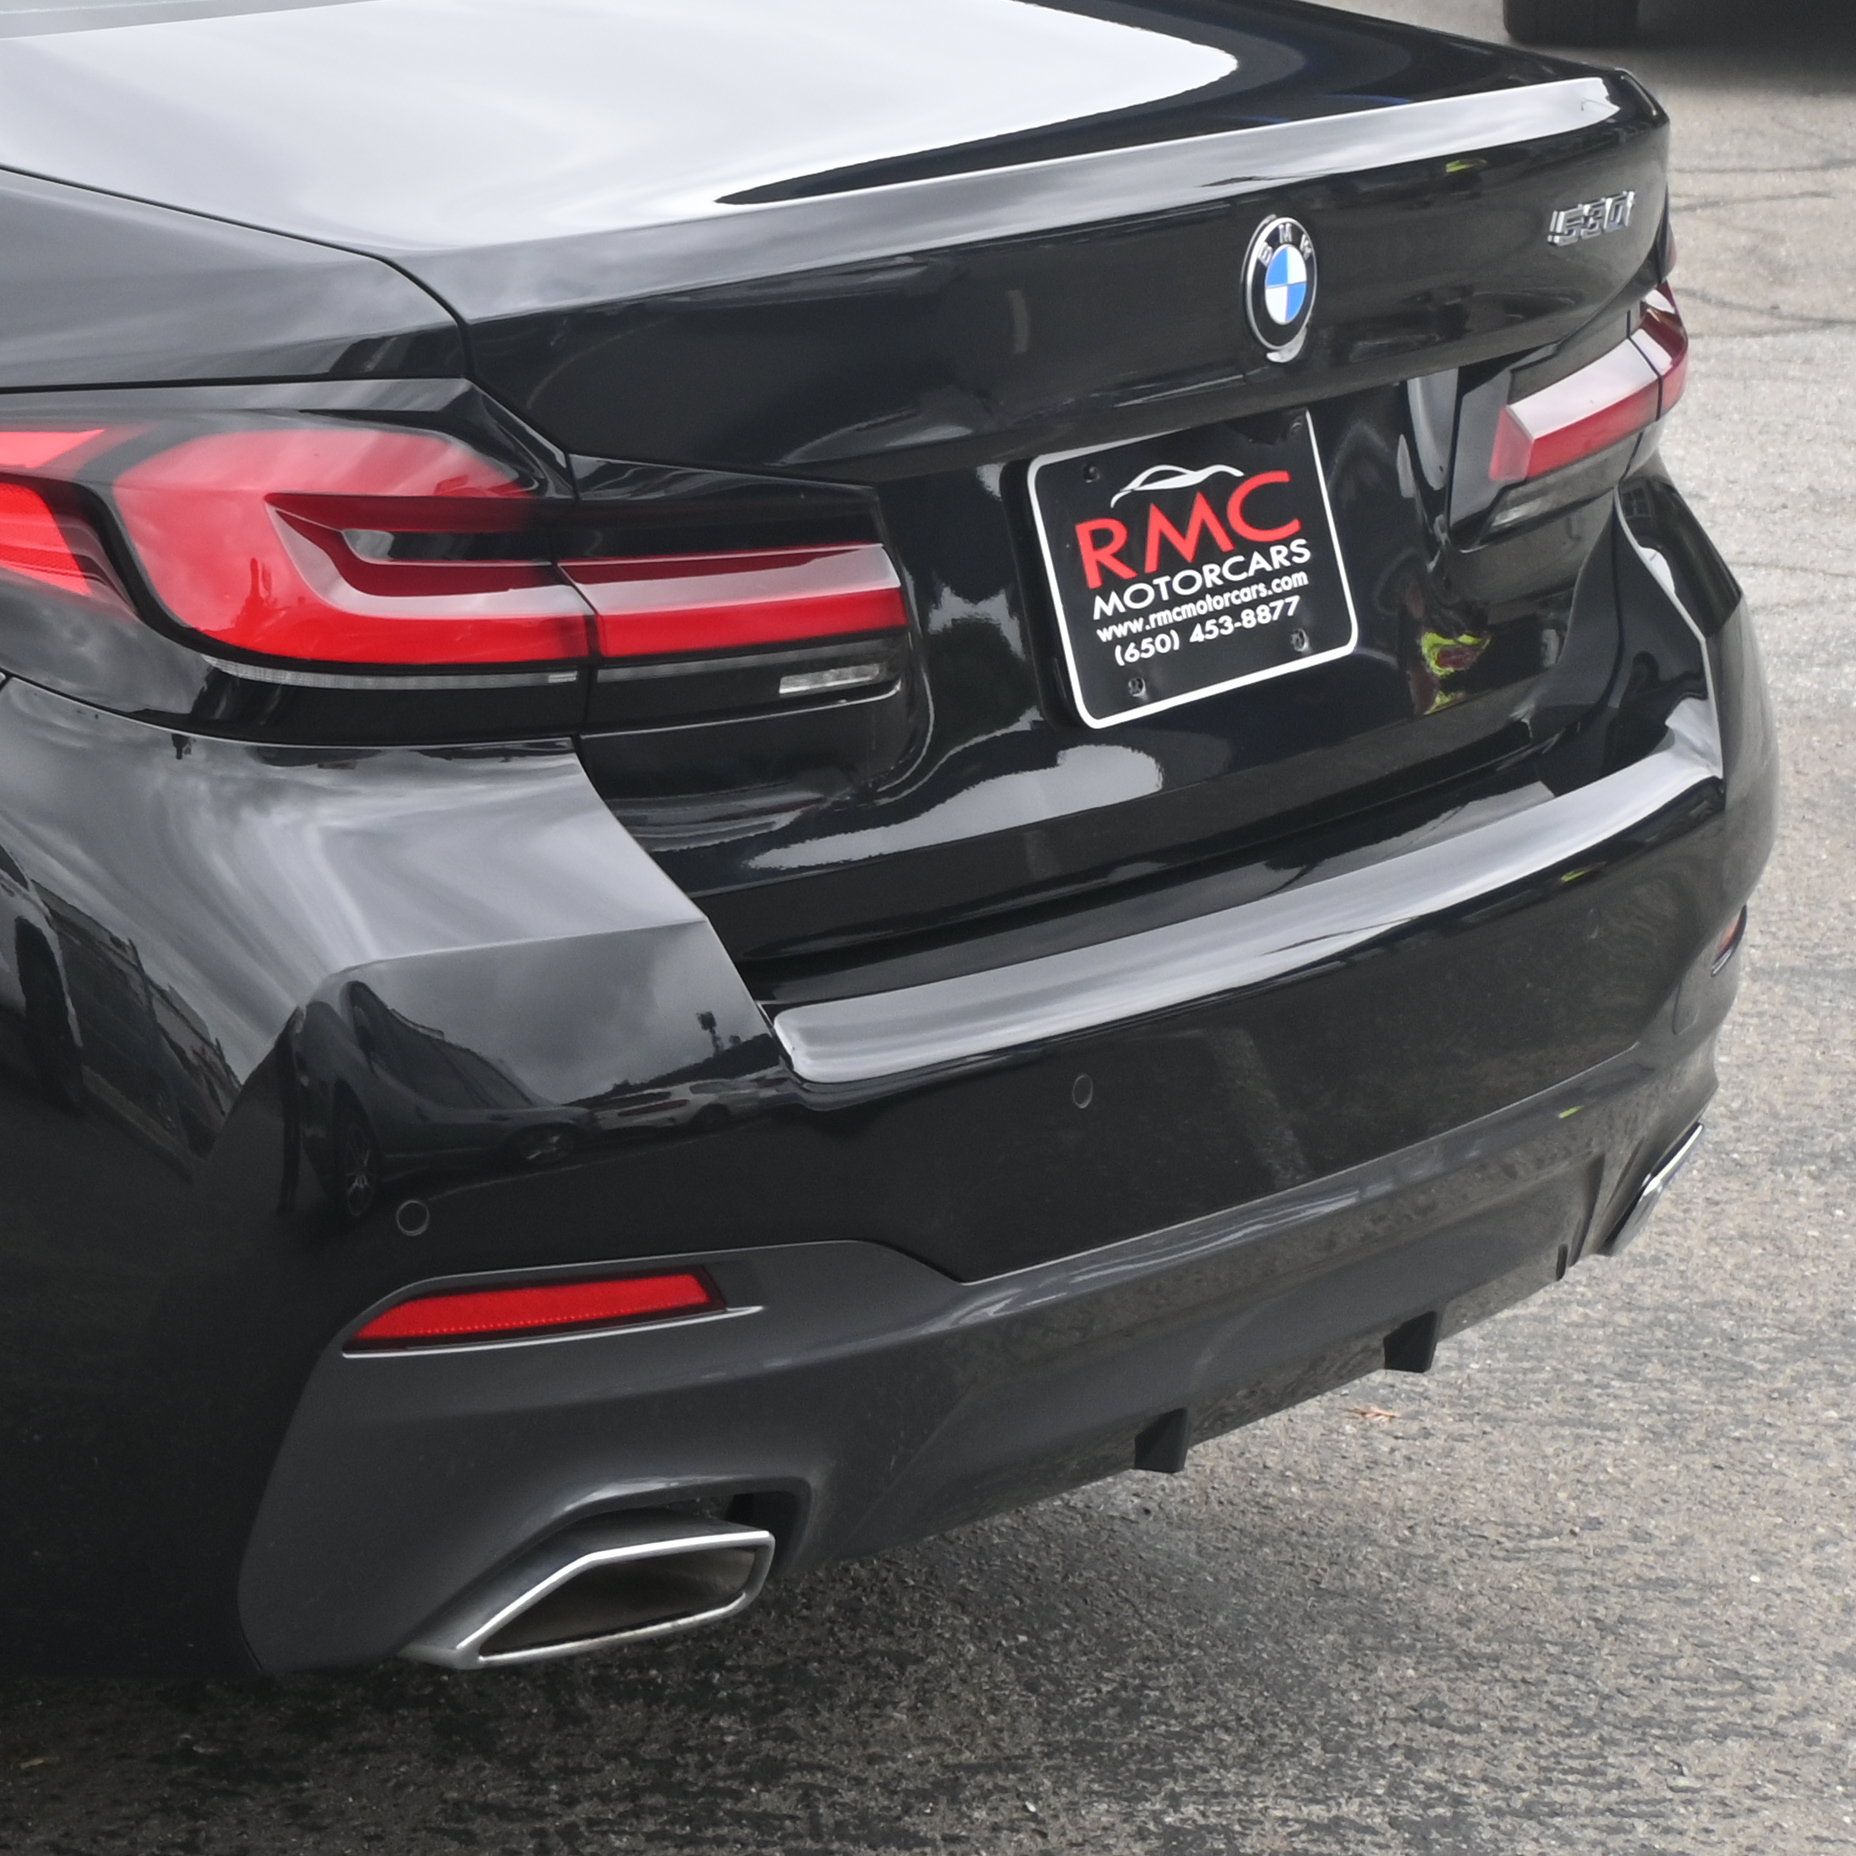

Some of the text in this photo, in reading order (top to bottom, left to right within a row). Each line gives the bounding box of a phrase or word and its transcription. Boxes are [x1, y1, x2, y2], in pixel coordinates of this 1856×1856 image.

[1257, 222, 1313, 268] BMW
[1547, 190, 1636, 247] 530i
[1075, 470, 1301, 589] RMC
[1091, 539, 1311, 621] MOTORCARS
[1096, 570, 1309, 643] www.rmcmotorcars.com
[1114, 596, 1301, 666] (650) 453-8877
